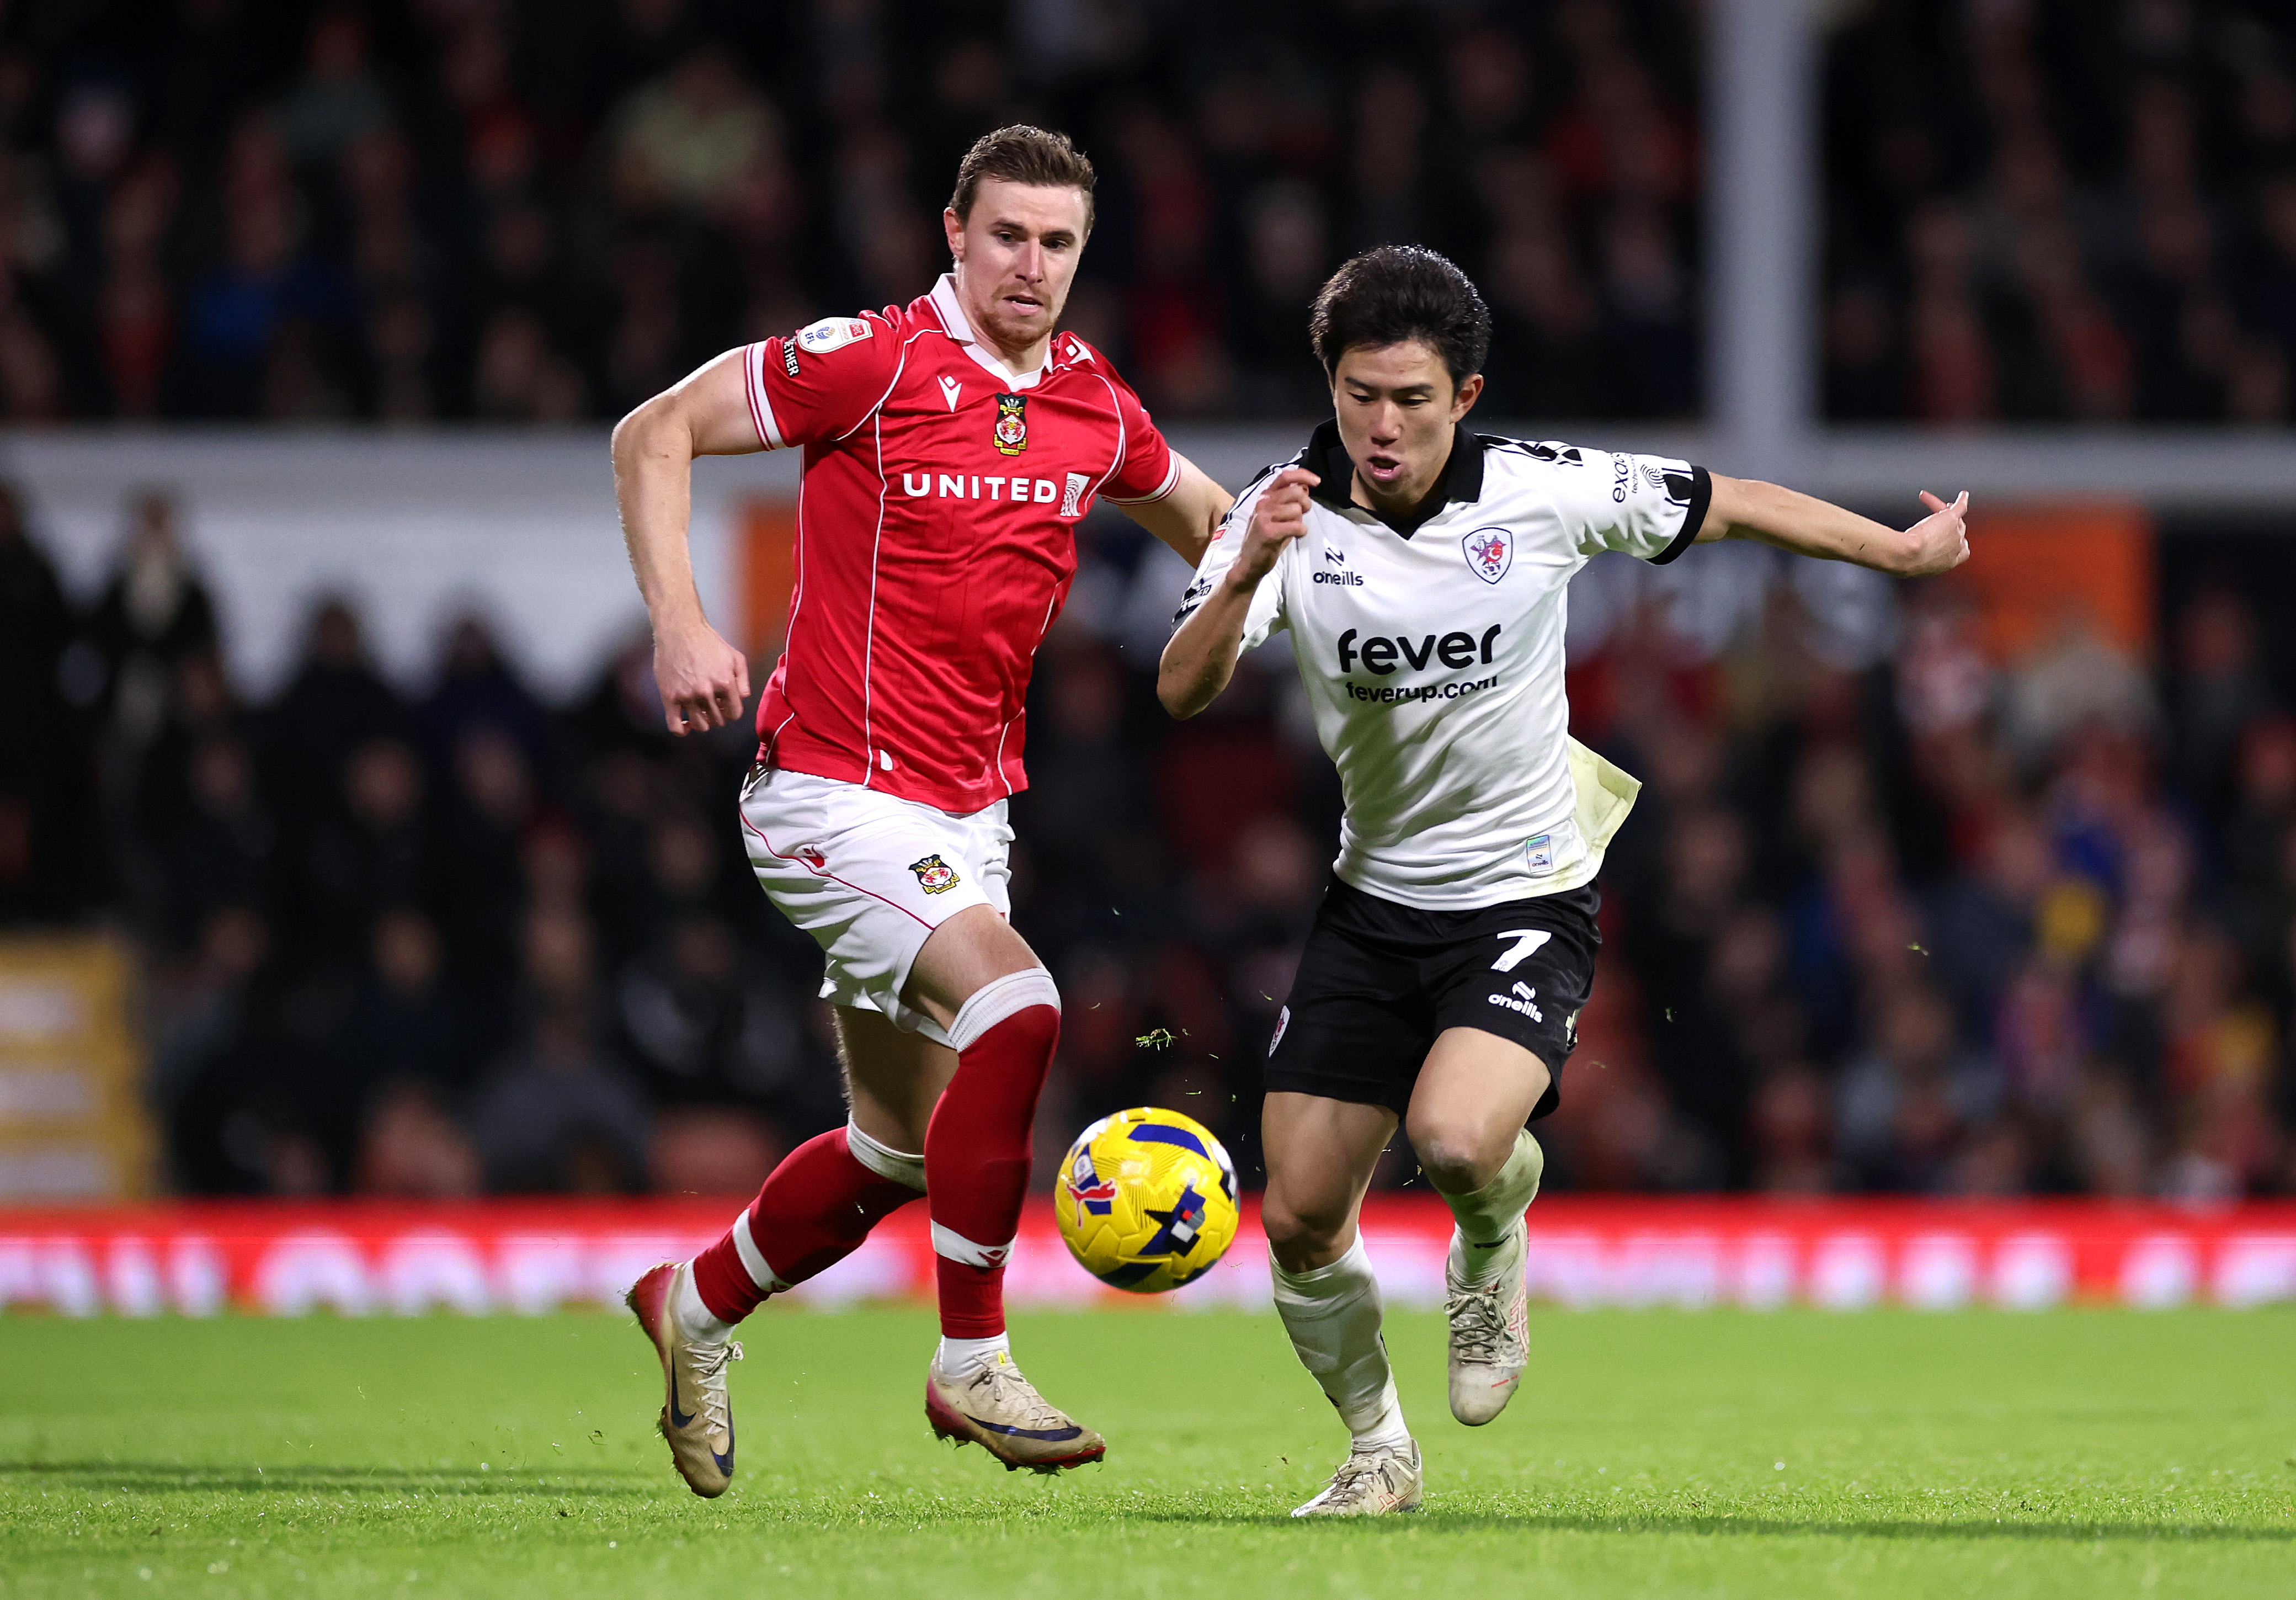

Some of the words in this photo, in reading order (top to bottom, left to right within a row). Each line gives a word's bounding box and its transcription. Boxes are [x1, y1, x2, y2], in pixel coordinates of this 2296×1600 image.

[805, 332, 816, 344] EFL
[903, 472, 1058, 503] UNITED
[1337, 623, 1501, 676] fever
[1345, 675, 1498, 703] feverup.com
[1490, 928, 1552, 972] 7
